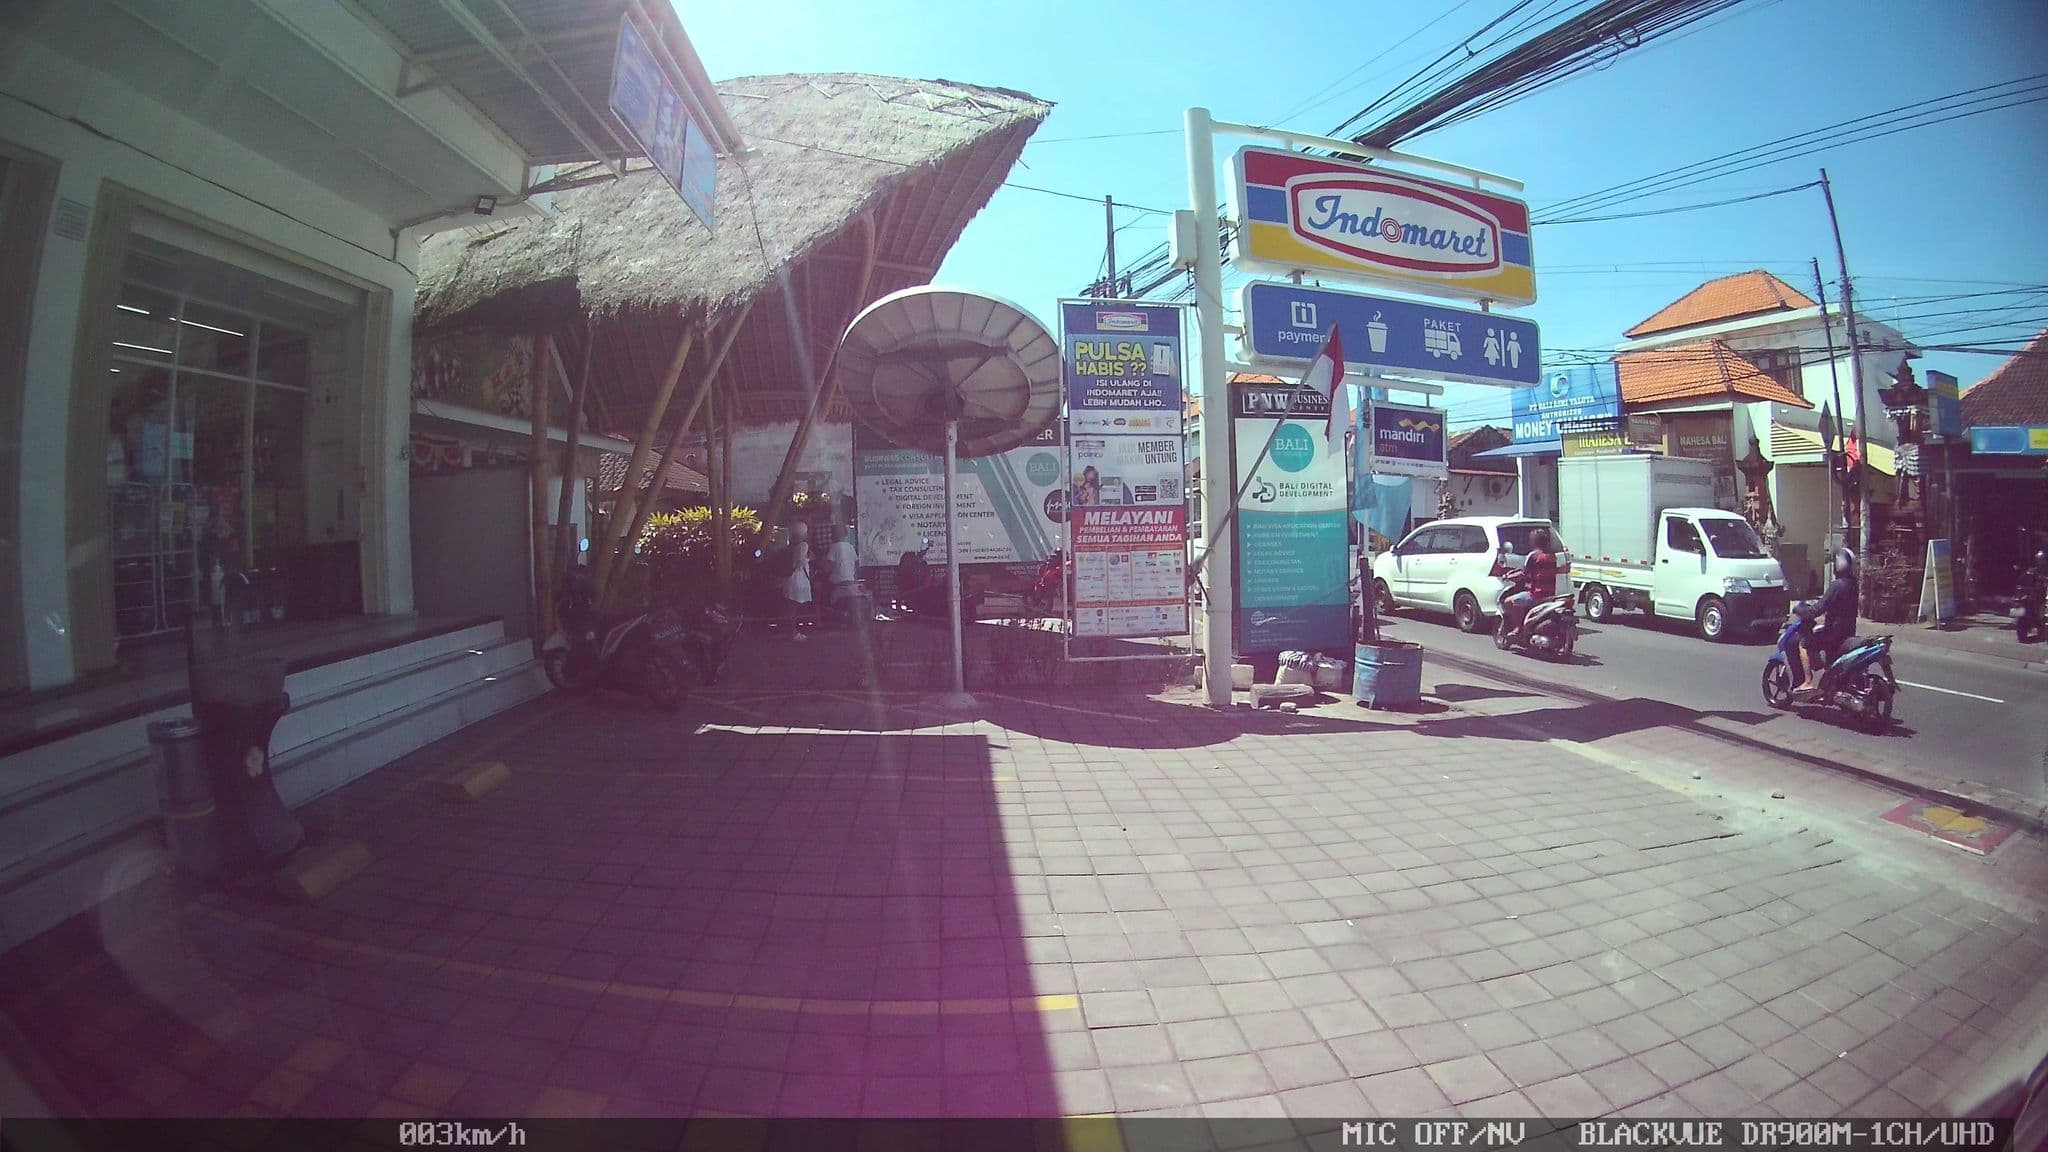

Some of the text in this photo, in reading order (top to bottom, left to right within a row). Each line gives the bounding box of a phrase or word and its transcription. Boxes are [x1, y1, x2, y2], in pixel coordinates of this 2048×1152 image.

[1307, 195, 1488, 258] Indomaret
[1424, 318, 1461, 332] PAKET
[1074, 341, 1146, 361] PULSA
[1076, 361, 1147, 377] HABIS ??
[1096, 379, 1107, 387] ISI
[1086, 389, 1138, 397] INDOMARET
[1083, 398, 1107, 406] LEBIH
[1541, 408, 1582, 419] AUTHORIZED
[1515, 419, 1552, 439] MONEY
[1380, 428, 1424, 443] mandiri
[1138, 440, 1174, 453] MEMBER
[1275, 438, 1309, 450] BALI
[1380, 443, 1398, 453] atm
[1145, 452, 1177, 464] UNTUNG
[1279, 482, 1333, 490] BALI DIGITAL
[1084, 511, 1174, 525] MELAYANI
[1076, 533, 1182, 543] SEMUA TAGIHAN ANDA
